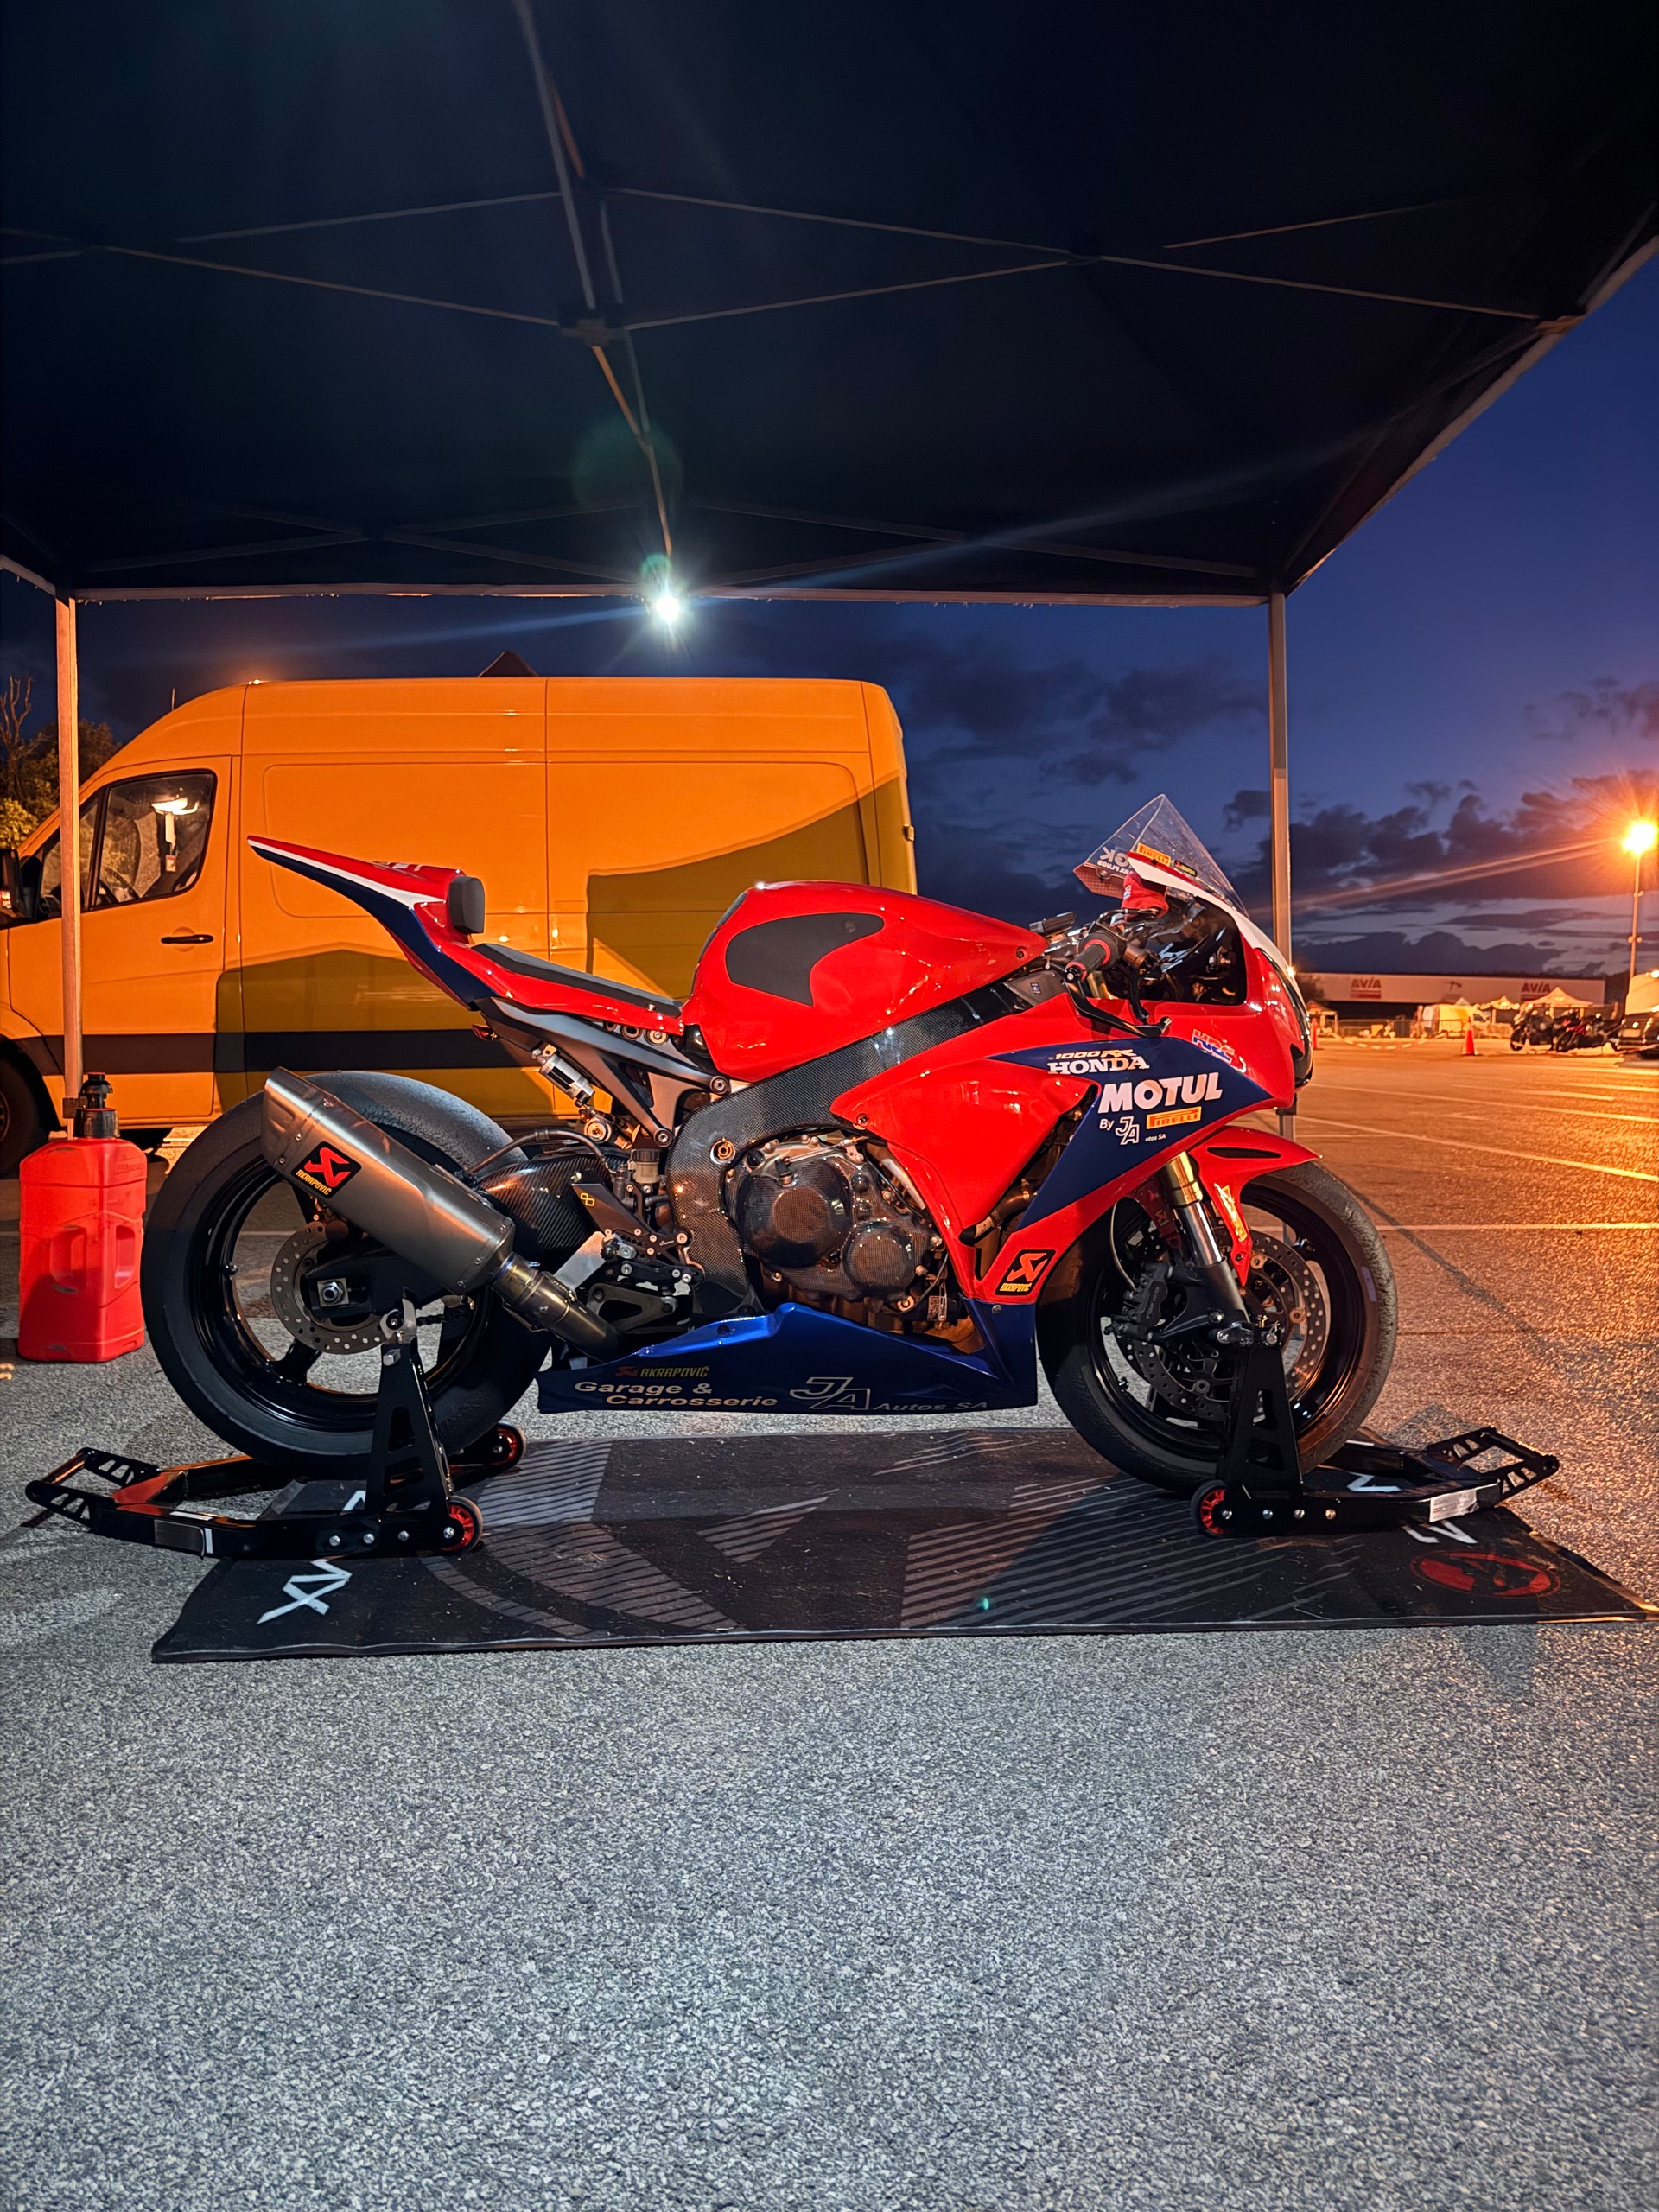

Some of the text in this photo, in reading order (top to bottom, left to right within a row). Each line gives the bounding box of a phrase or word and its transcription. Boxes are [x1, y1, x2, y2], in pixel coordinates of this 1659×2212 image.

[1351, 978, 1382, 988] AVIA
[1522, 982, 1552, 993] AVIA
[1192, 1029, 1235, 1063] HRC
[1047, 1056, 1150, 1074] HONDA
[1097, 1072, 1223, 1114] MOTUL
[1099, 1118, 1115, 1131] By
[1148, 1108, 1199, 1128] PIRELLI
[575, 1382, 713, 1396] Garage &
[606, 1395, 778, 1406] Carrosserie
[873, 1402, 947, 1411] Autos
[954, 1401, 988, 1410] SA
